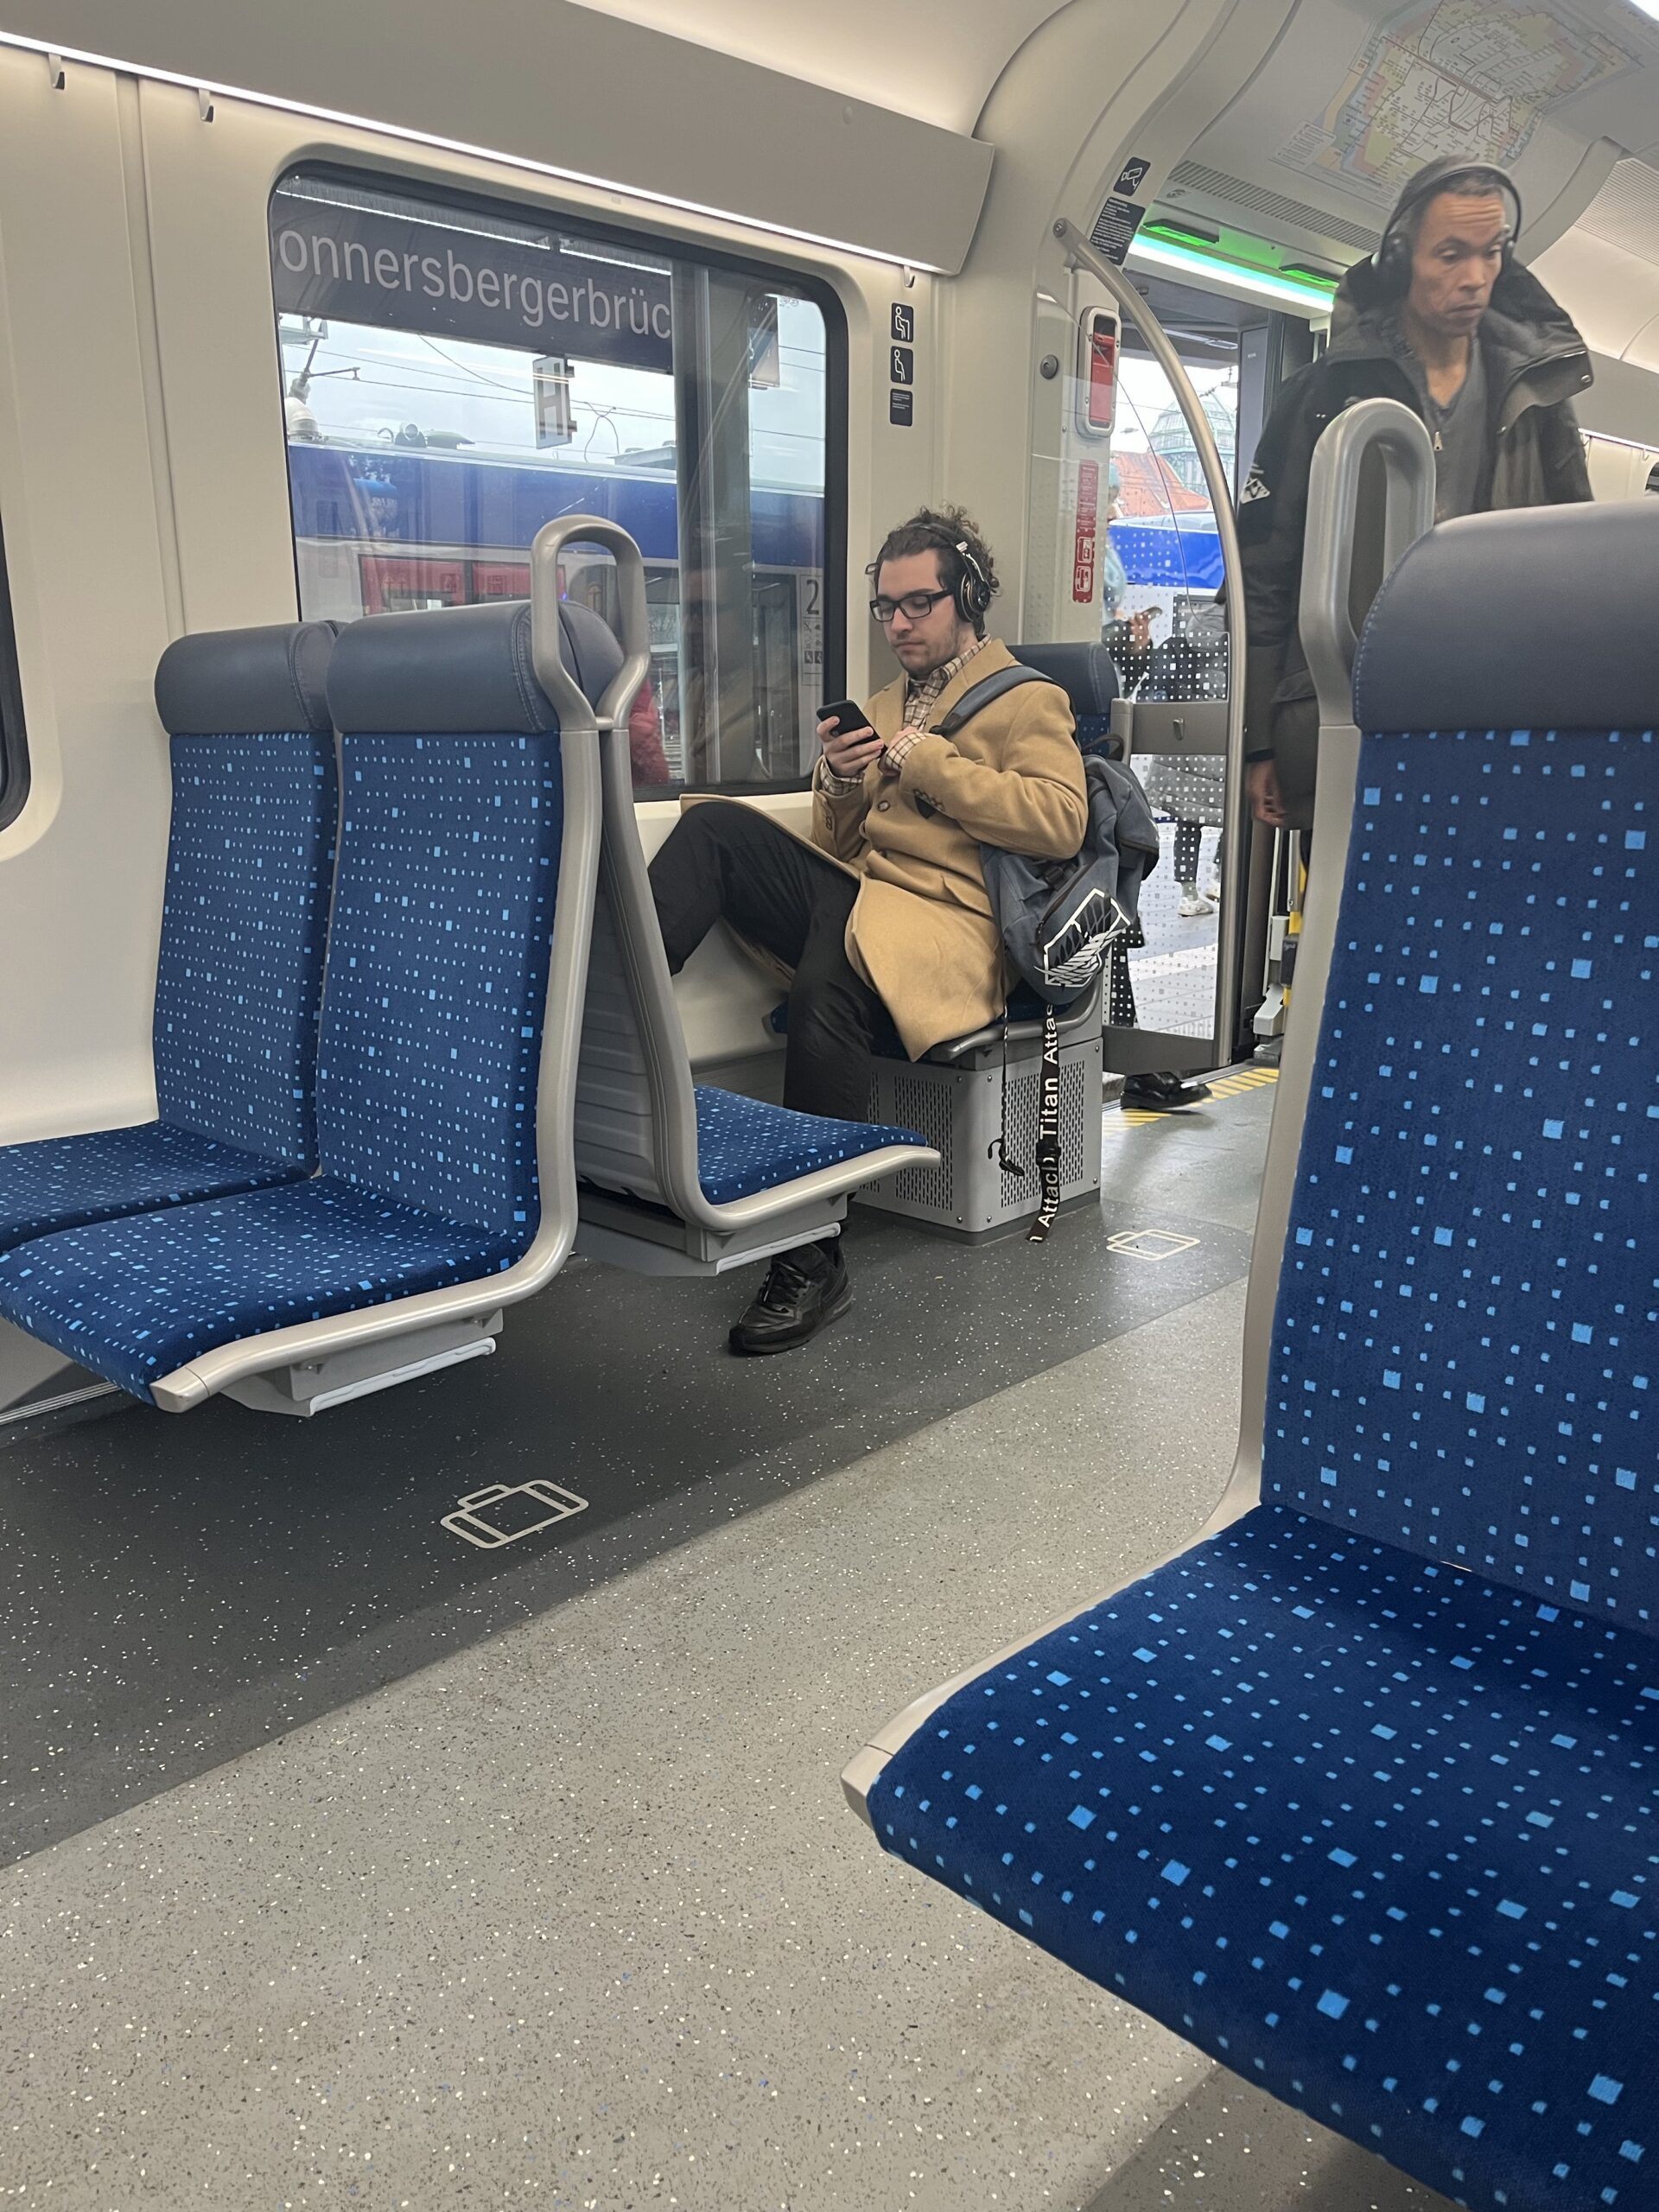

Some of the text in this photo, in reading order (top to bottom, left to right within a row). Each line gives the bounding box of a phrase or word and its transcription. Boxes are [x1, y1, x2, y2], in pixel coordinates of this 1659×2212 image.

[279, 229, 671, 340] onnersbergerbrüc
[537, 363, 563, 439] H
[806, 578, 820, 615] 2
[1039, 1077, 1058, 1140] Titan
